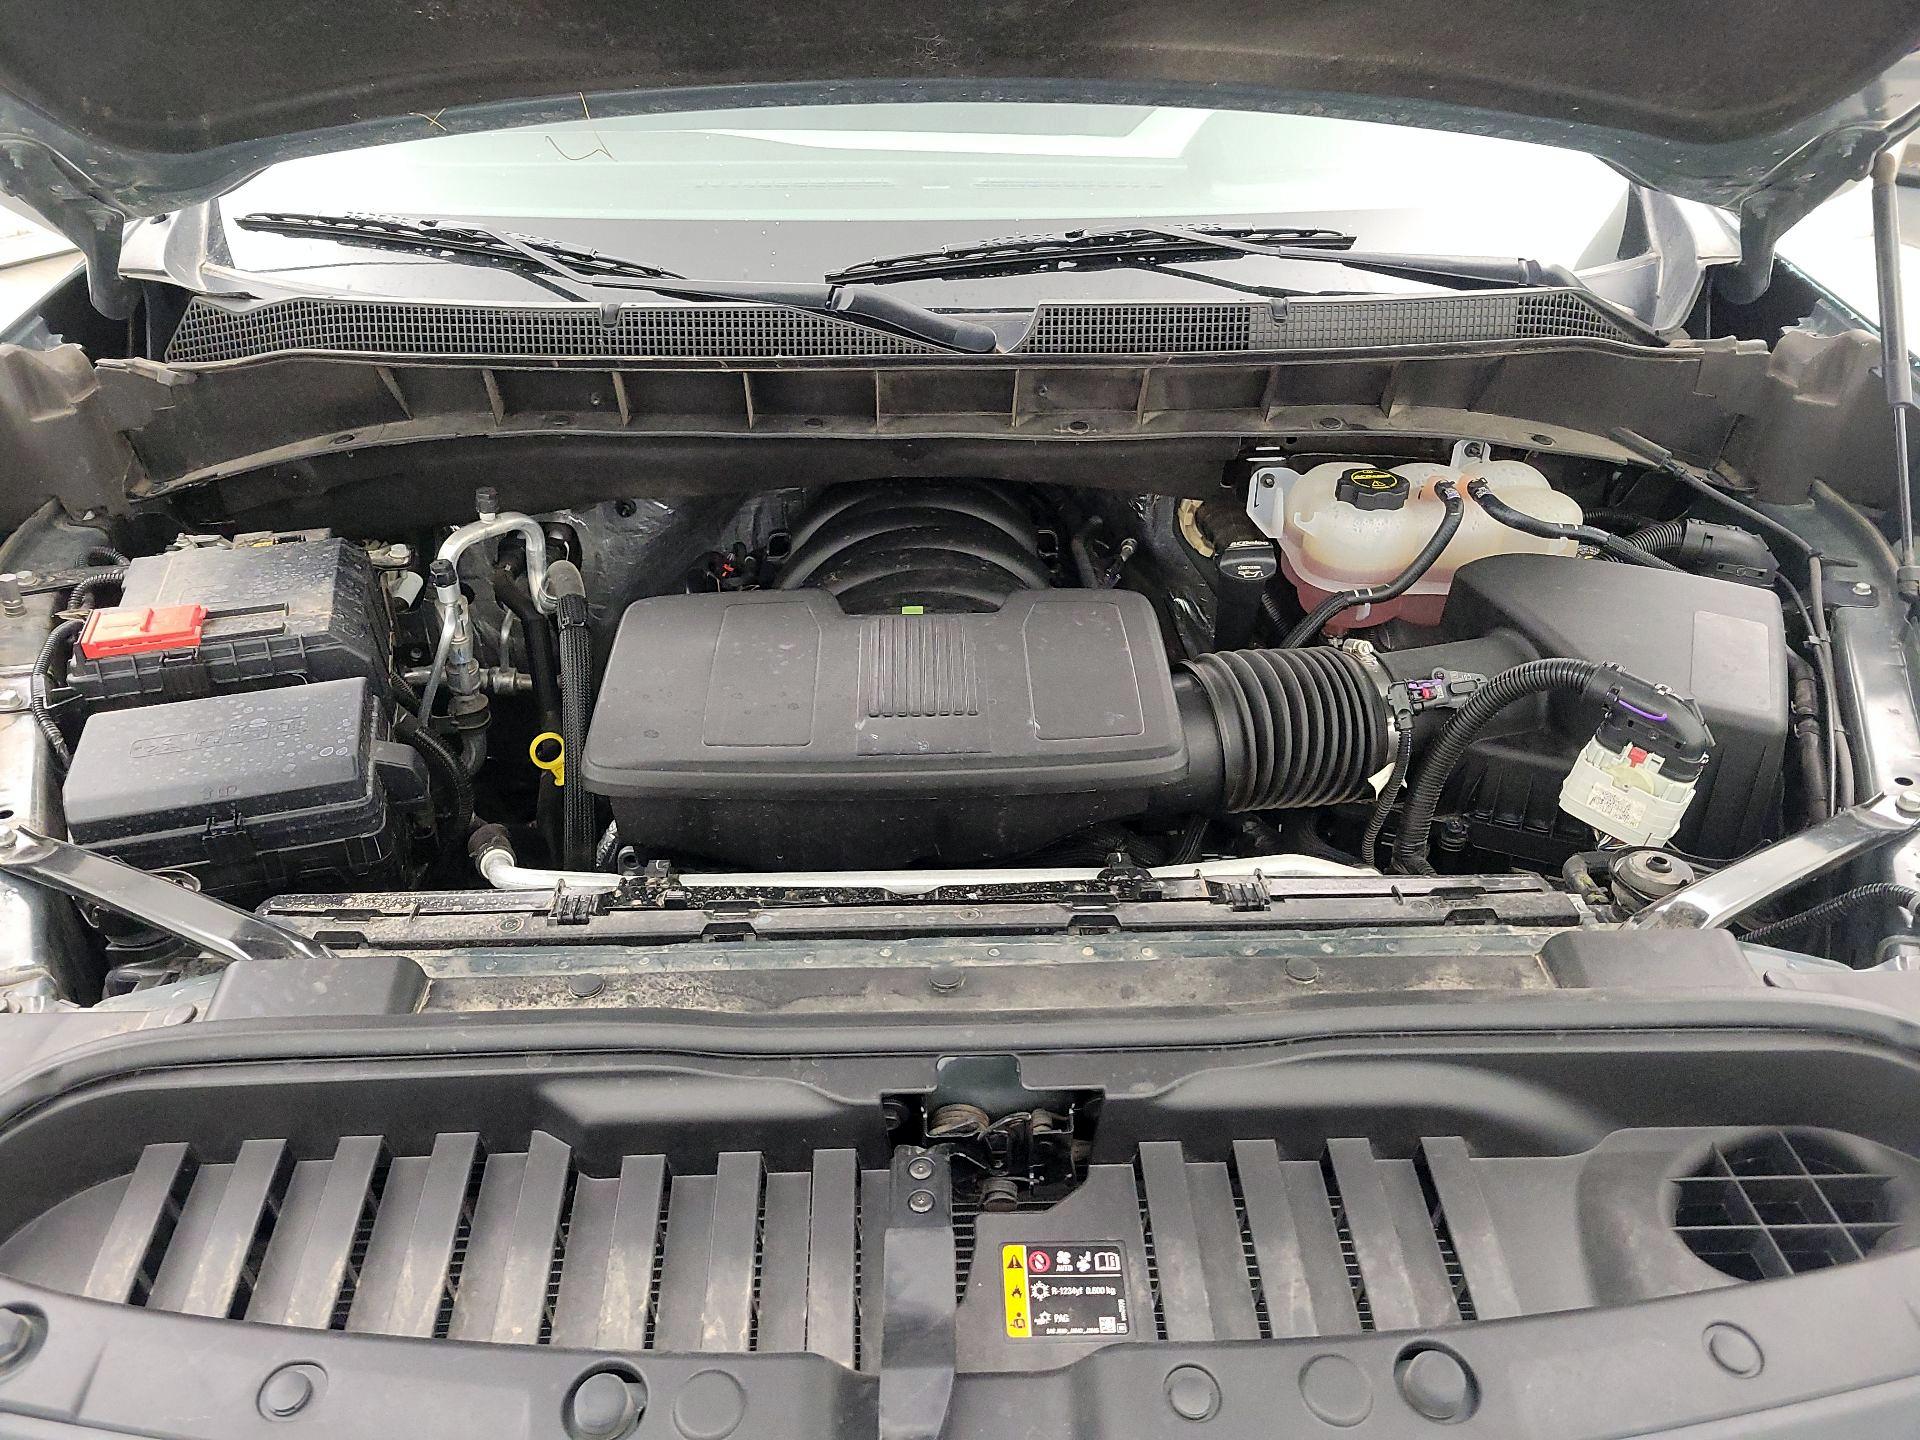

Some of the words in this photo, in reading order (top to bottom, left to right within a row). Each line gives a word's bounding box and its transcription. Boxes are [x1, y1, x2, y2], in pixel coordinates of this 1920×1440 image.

[1051, 1286, 1084, 1297] R-1234yf
[1106, 1286, 1117, 1296] kg
[1053, 1313, 1070, 1323] PAG
